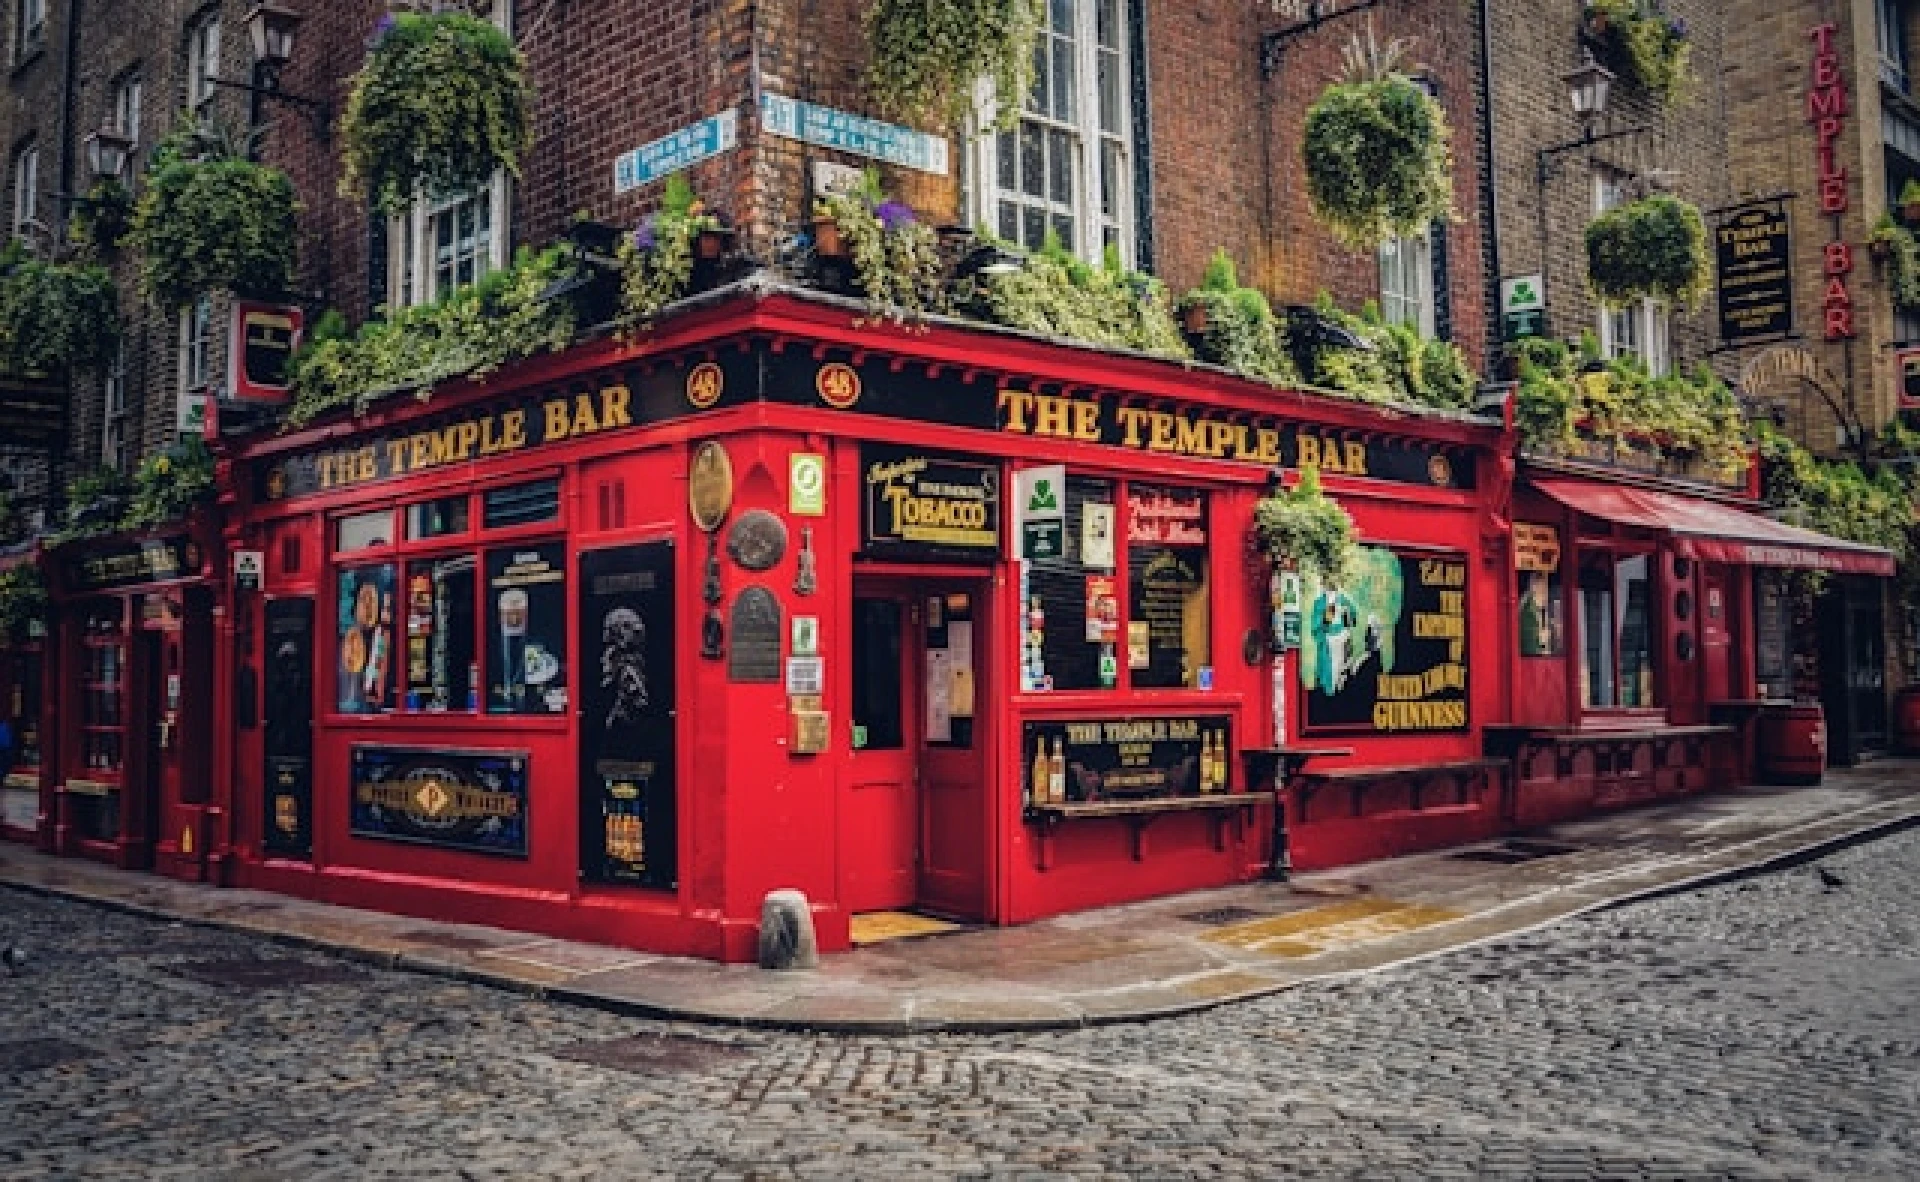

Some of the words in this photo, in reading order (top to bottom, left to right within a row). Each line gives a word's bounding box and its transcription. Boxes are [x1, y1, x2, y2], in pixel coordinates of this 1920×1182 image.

[1808, 22, 1848, 212] TEMPLE
[1824, 242, 1852, 338] BAR
[315, 446, 376, 488] THE
[386, 410, 526, 472] TEMPLE
[544, 385, 632, 442] BAR
[1000, 389, 1101, 442] THE
[1117, 407, 1281, 465] TEMPLE
[1296, 433, 1368, 476] BAR
[884, 486, 987, 535] TOBACCO
[1373, 701, 1465, 729] GUINNESS
